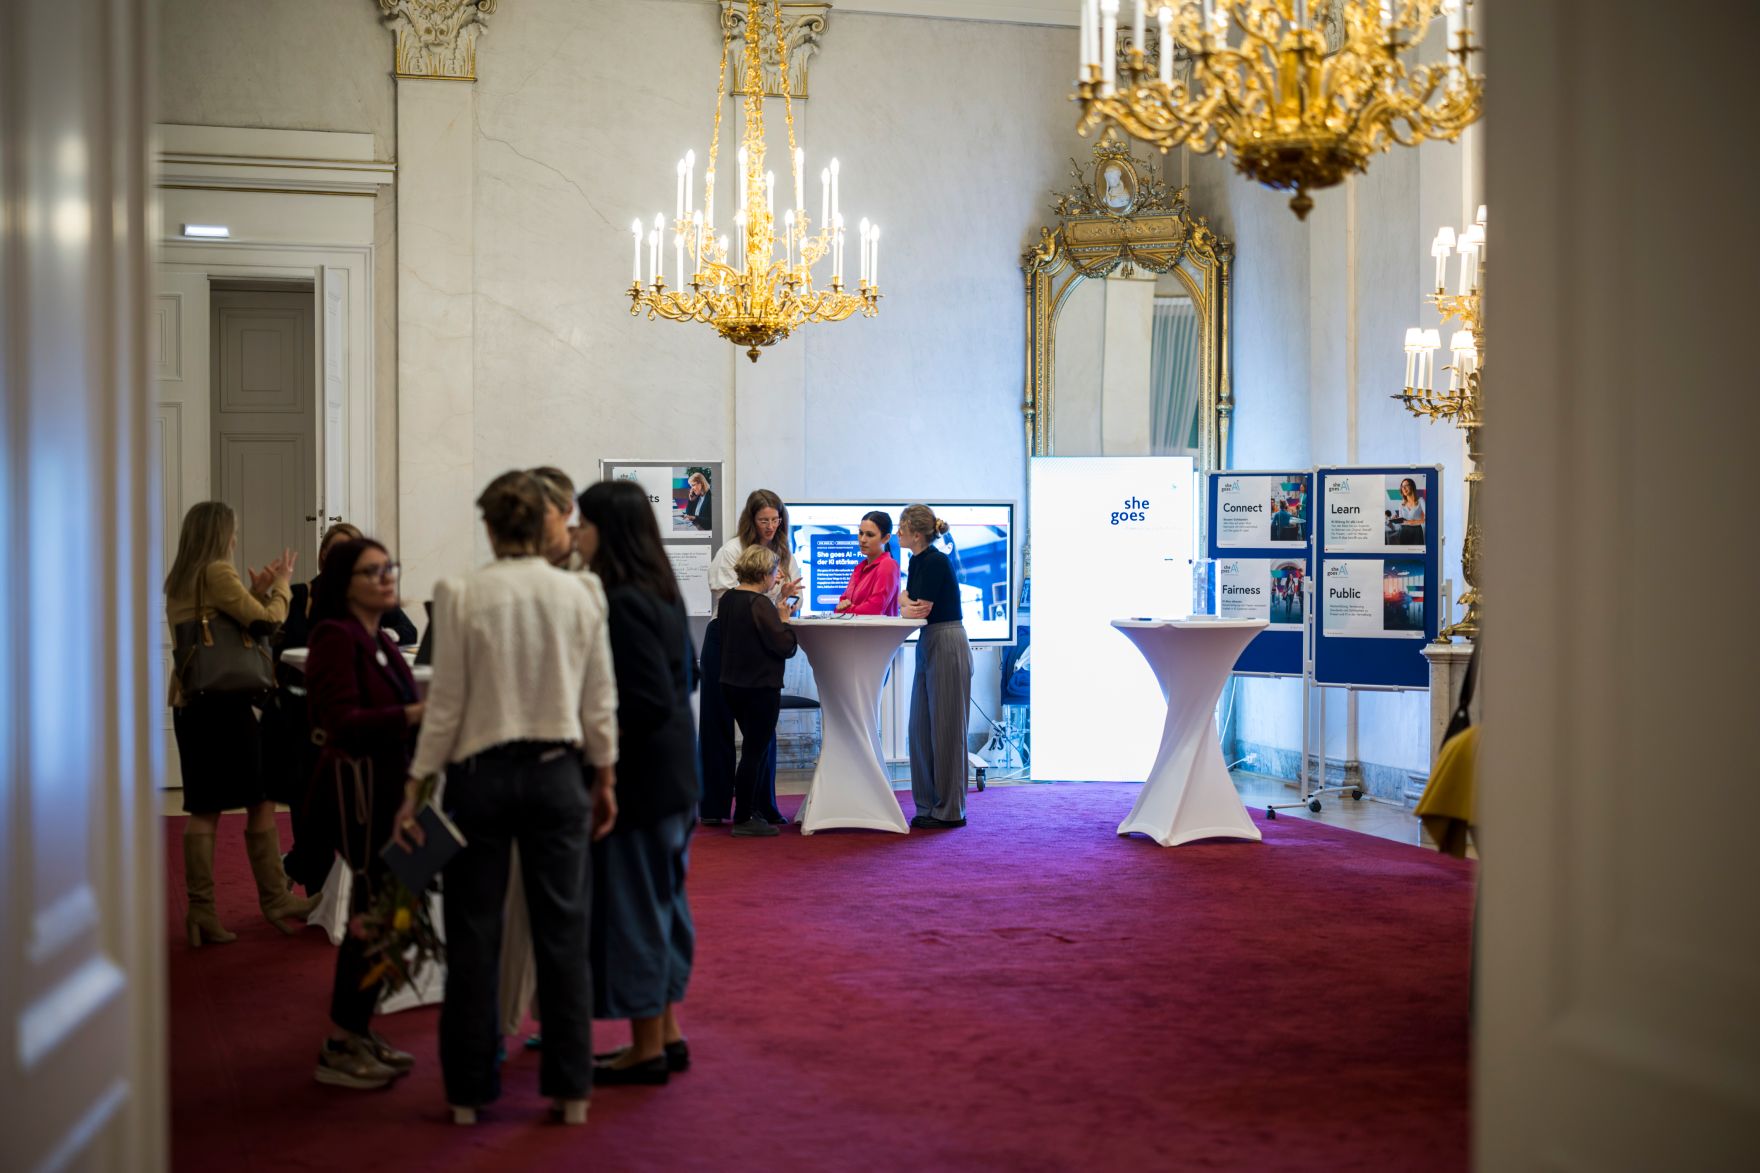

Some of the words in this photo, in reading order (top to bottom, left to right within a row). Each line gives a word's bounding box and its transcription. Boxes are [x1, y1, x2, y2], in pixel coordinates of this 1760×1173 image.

[1124, 496, 1150, 510] she
[1223, 502, 1263, 513] Connect
[1331, 503, 1361, 514] Learn
[1110, 511, 1145, 526] goes
[1222, 584, 1261, 595] Fairness
[1329, 587, 1361, 599] Public
